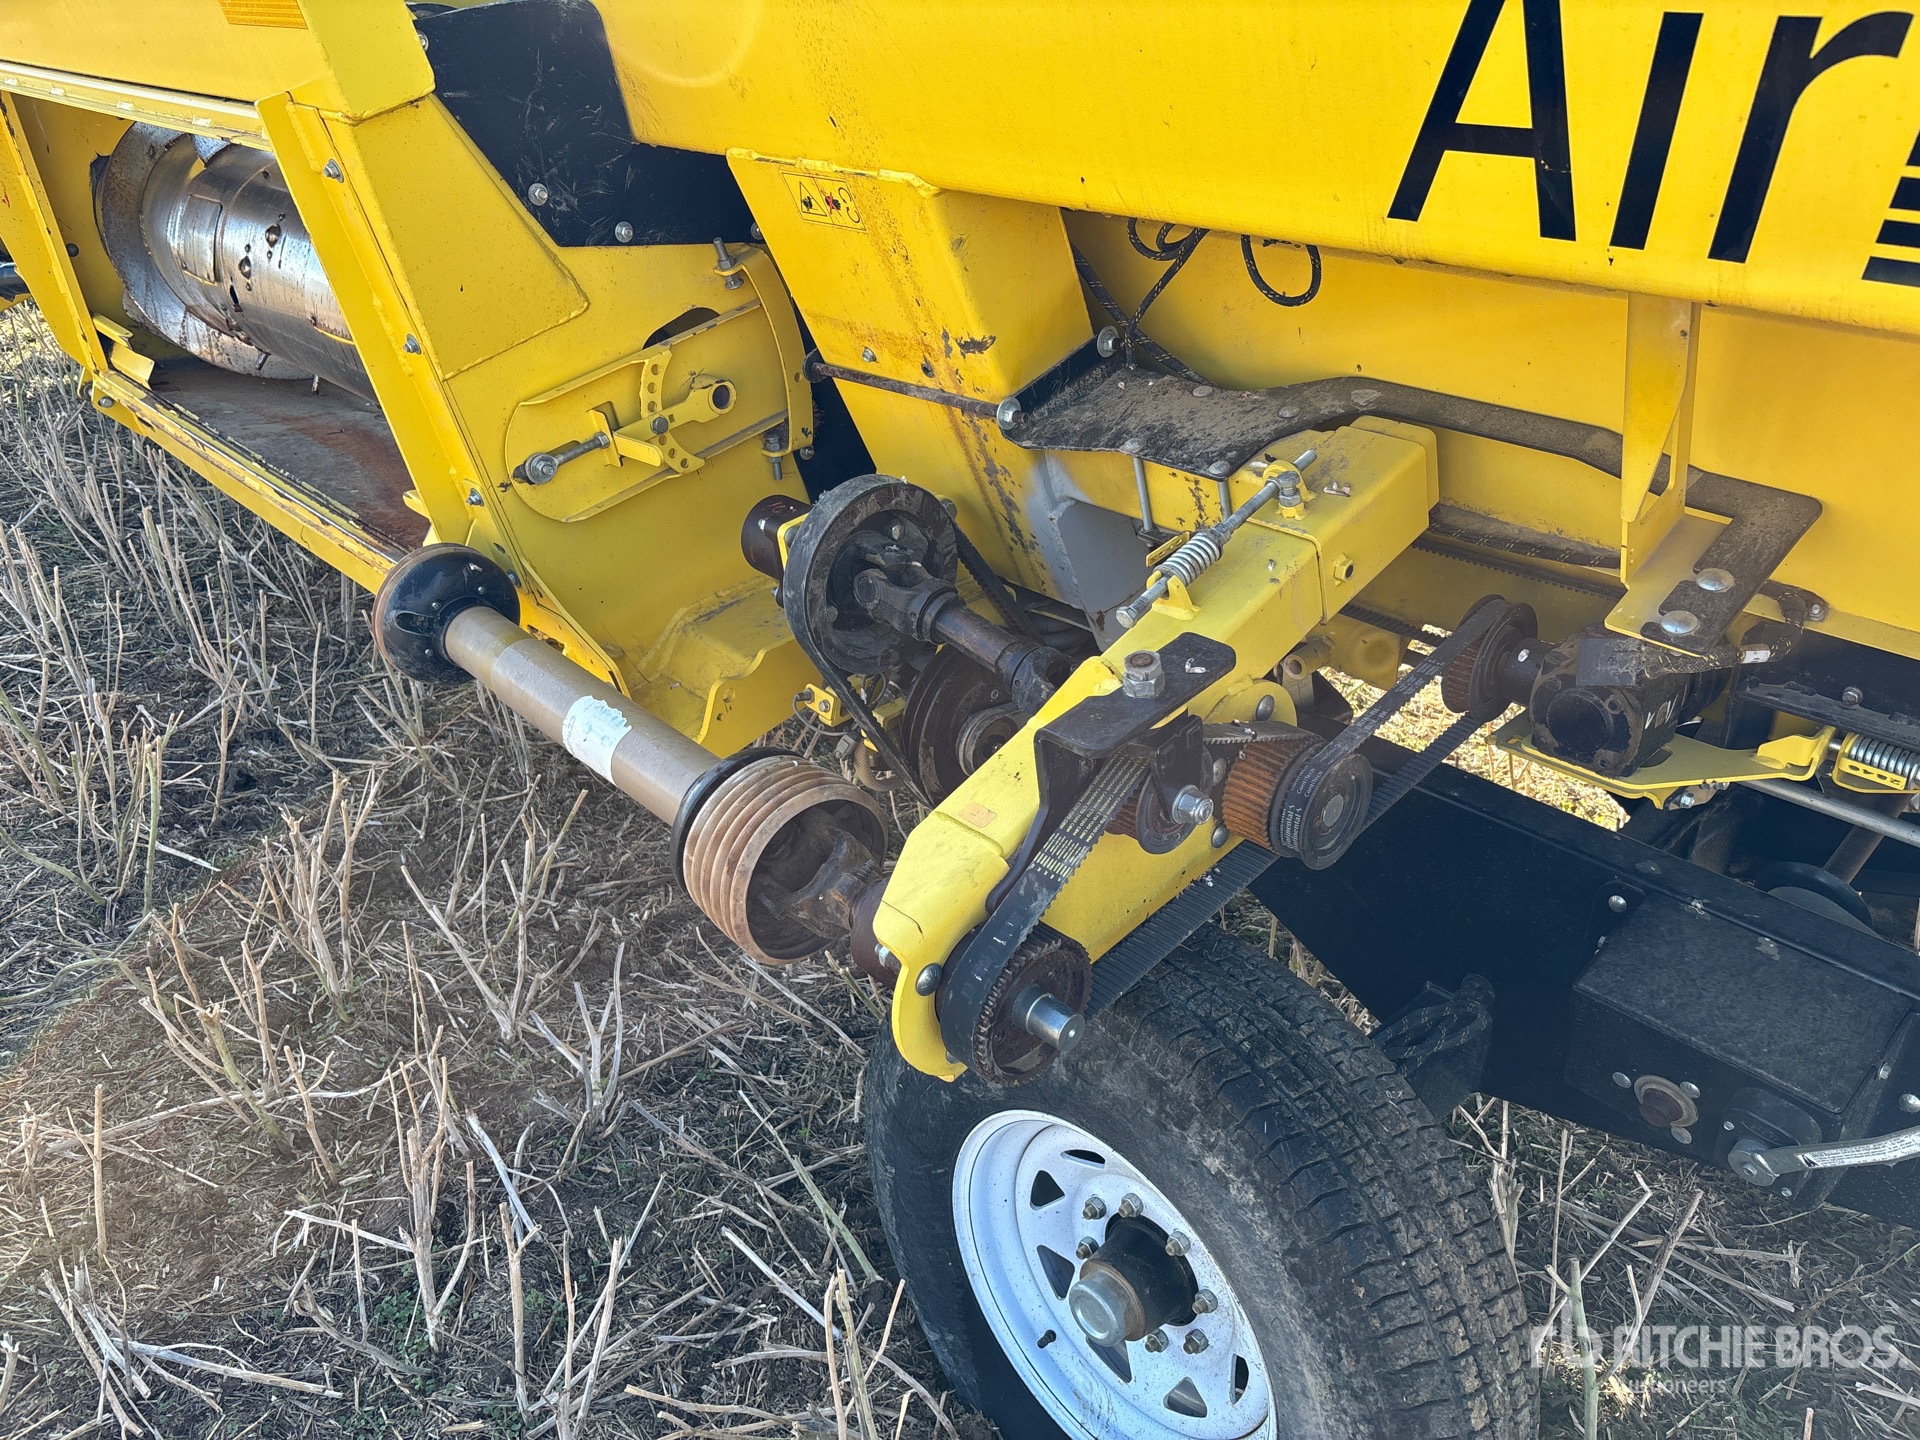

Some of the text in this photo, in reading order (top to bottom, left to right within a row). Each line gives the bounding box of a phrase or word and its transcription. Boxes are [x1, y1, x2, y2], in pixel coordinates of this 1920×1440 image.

[1084, 786, 1101, 806] CARBON
[1091, 789, 1108, 809] CARBON
[1098, 793, 1114, 812] CARBON
[1104, 796, 1121, 815] CARBON
